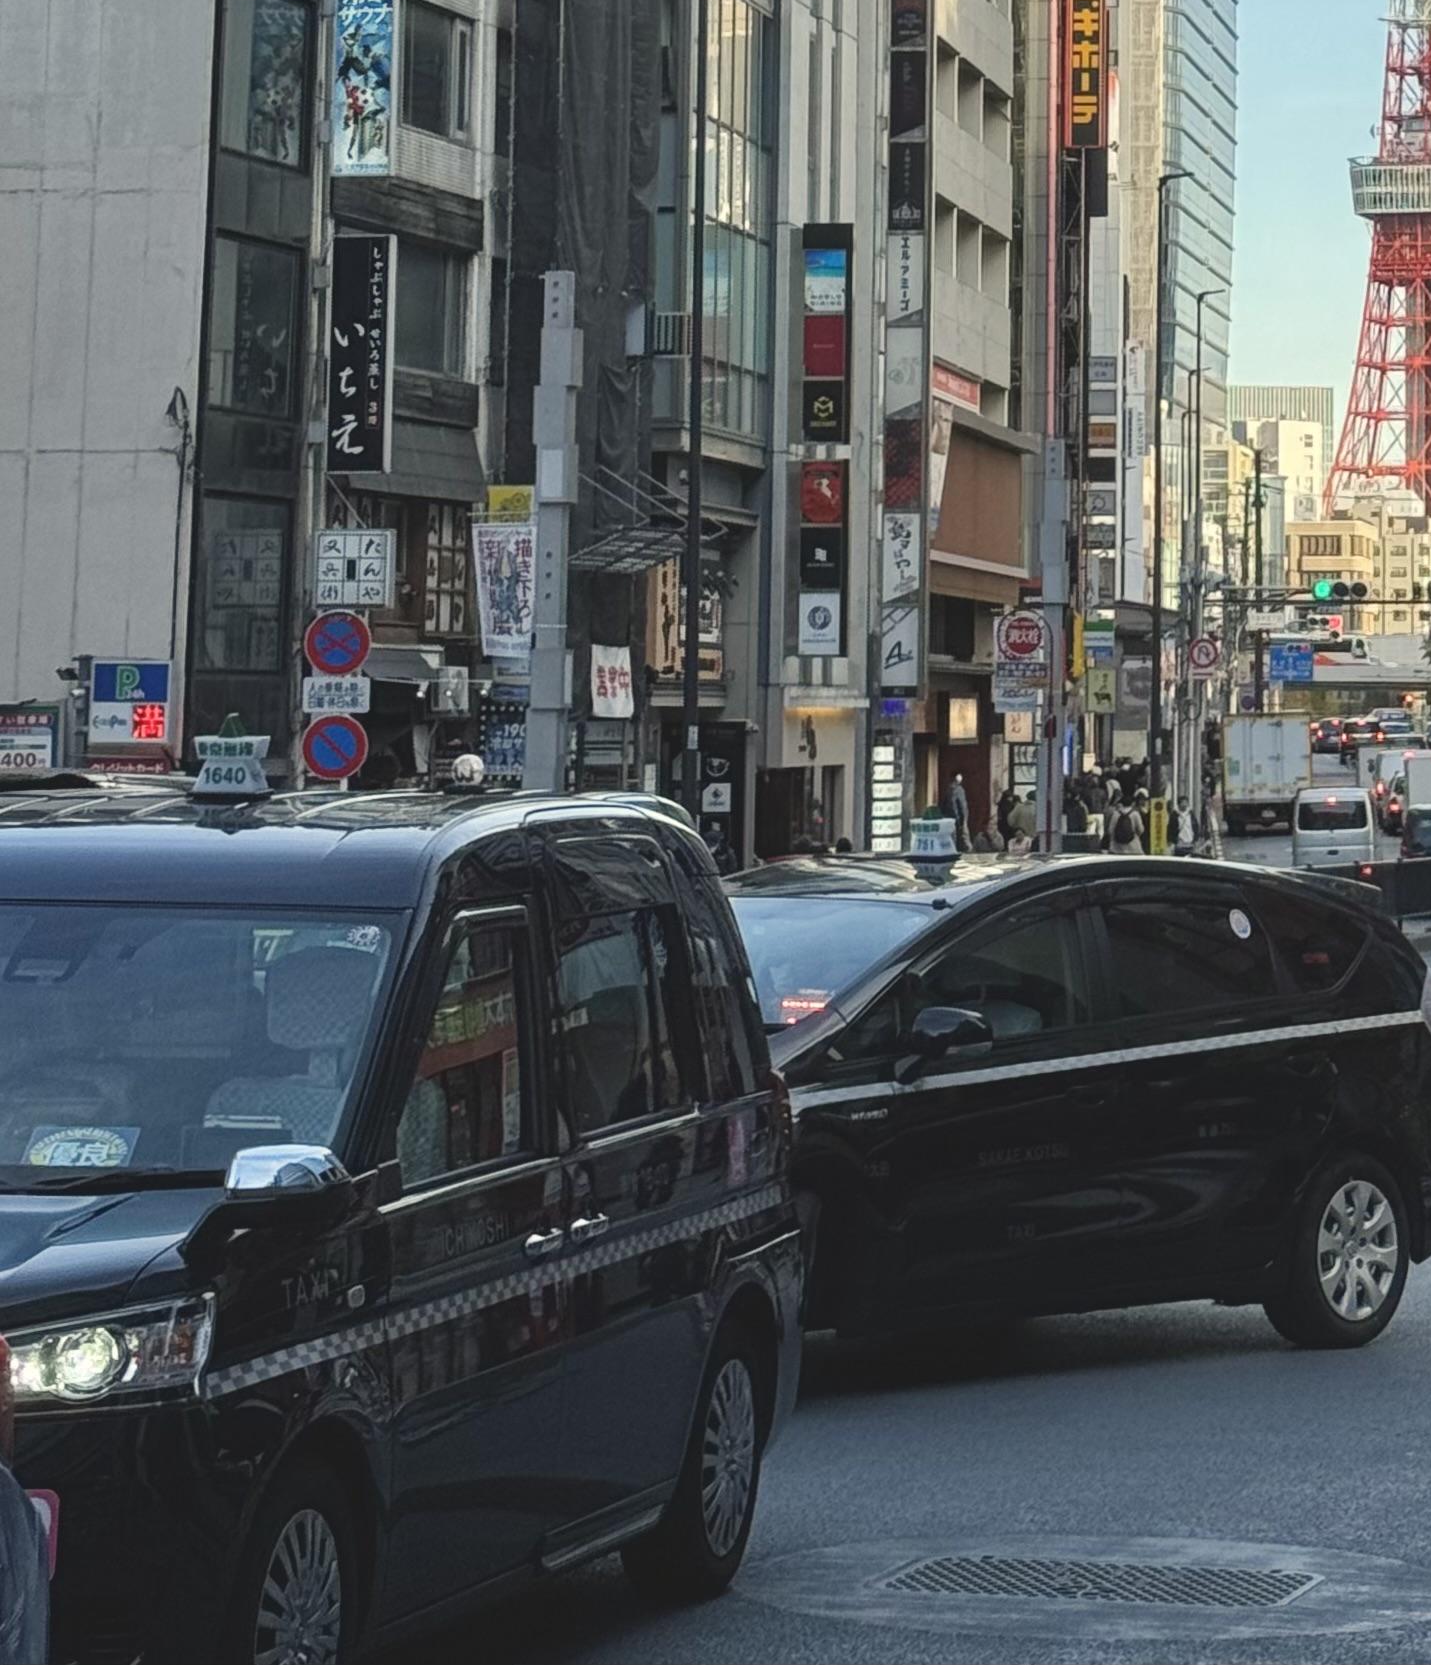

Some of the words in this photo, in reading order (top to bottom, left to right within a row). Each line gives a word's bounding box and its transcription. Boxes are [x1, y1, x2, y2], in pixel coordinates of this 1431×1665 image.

[338, 5, 393, 26] サウナ
[368, 247, 384, 320] しゃぶしゃぶ
[331, 322, 367, 455] いちえ
[116, 665, 141, 700] P
[133, 704, 165, 740] 満
[204, 767, 246, 785] 1640
